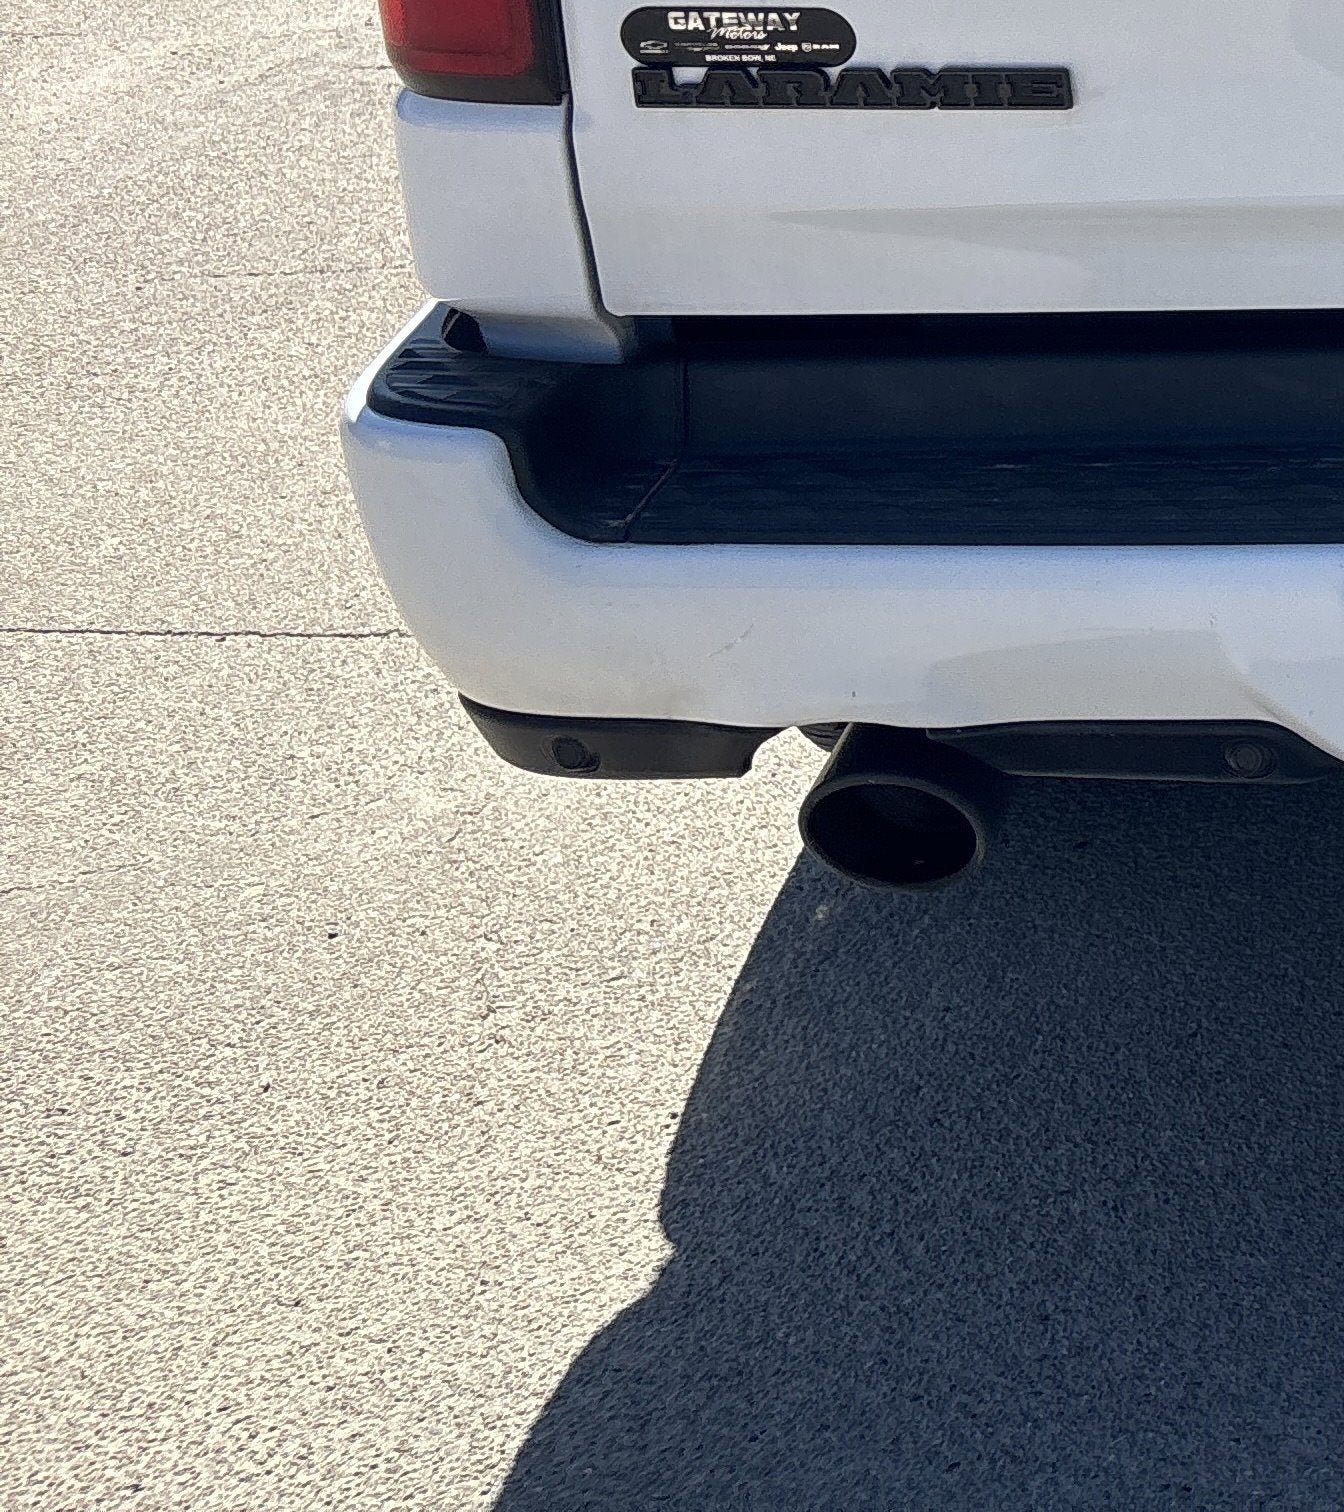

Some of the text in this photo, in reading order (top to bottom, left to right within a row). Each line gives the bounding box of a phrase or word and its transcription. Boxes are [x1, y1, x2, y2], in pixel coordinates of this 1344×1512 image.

[667, 10, 801, 31] GATEWAY
[706, 24, 768, 41] Motors
[632, 66, 1073, 109] LARAMIE
